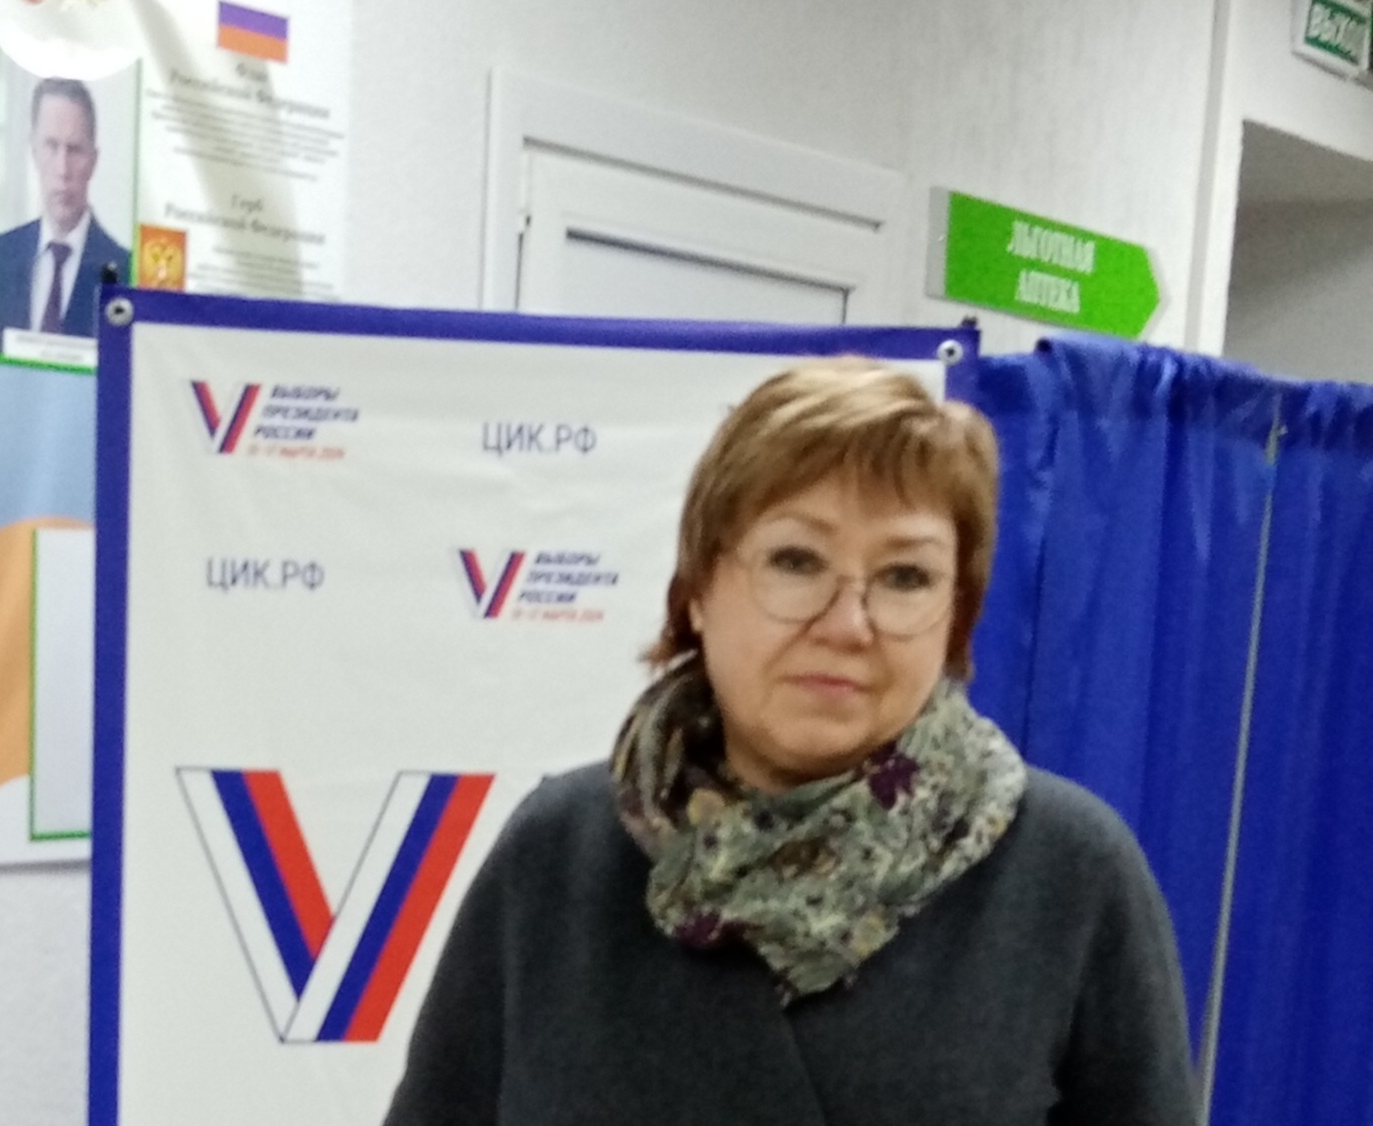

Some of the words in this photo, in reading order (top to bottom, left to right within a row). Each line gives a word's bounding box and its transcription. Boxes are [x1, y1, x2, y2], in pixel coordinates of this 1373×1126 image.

[271, 384, 341, 401] ВЫБОРЫ
[261, 404, 360, 422] ПРЕЗИДЕНТА
[254, 424, 316, 440] РОССИИ
[482, 421, 597, 457] ЦИК.РФ
[535, 552, 601, 567] ВЫБОРЫ
[206, 557, 326, 595] ЦИК.РФ
[527, 570, 619, 586] ПРЕЗИДЕНТА
[518, 589, 577, 604] РОССИИ
